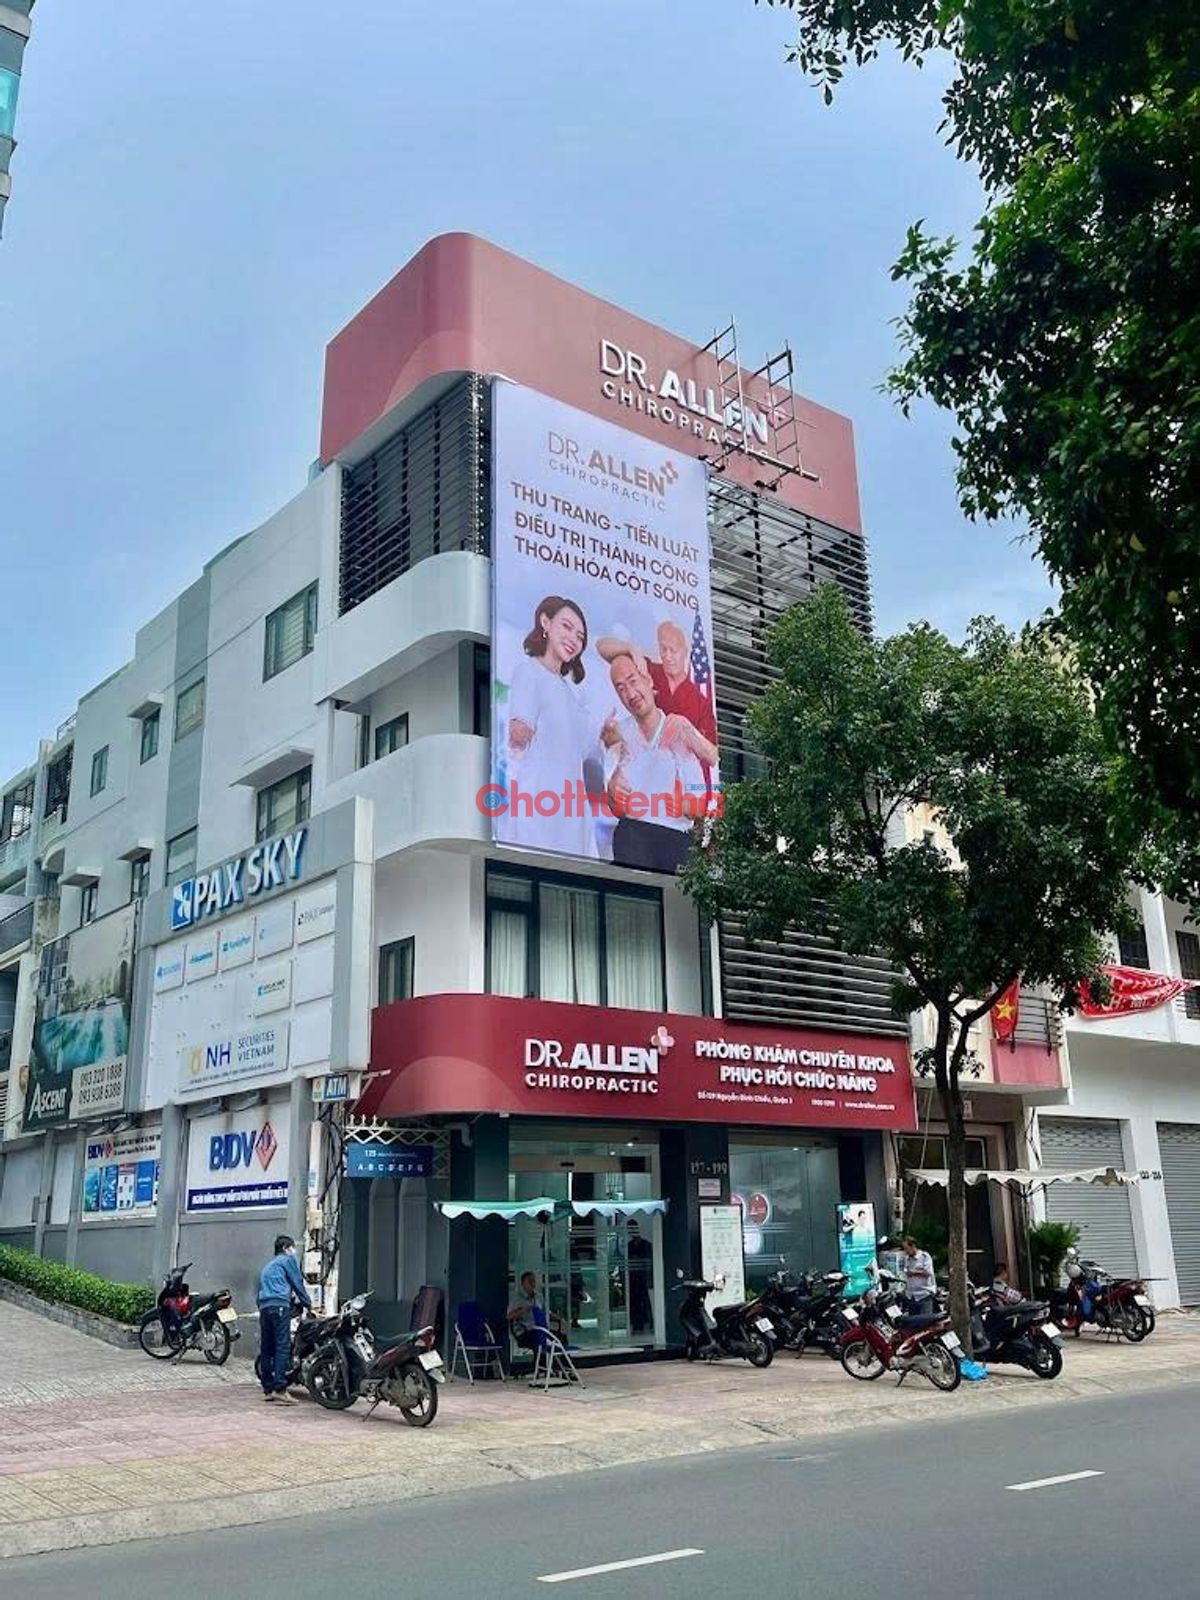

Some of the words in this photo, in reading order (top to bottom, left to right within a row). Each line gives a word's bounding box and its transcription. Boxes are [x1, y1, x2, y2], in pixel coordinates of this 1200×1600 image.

[549, 458, 667, 513] CHIROPRACTIC
[510, 482, 547, 507] THU
[551, 496, 611, 531] TRANG
[662, 536, 699, 563] LUẬT
[514, 535, 570, 568] THOÁI
[574, 556, 611, 582] HÓA
[615, 570, 650, 595] CỘT
[559, 527, 585, 554] TRỊ
[589, 537, 646, 571] THÀNH
[650, 559, 699, 588] CÔNG
[193, 856, 246, 921] PAX
[246, 827, 308, 897] SKY
[206, 1041, 232, 1070] NH
[237, 1044, 275, 1062] VIETNAM
[695, 1038, 752, 1061] PHÒNG
[753, 1043, 798, 1066] KHÁM
[798, 1050, 856, 1071] CHUYÊN
[857, 1055, 896, 1074] KHOA
[325, 1077, 347, 1098] ATM
[525, 1073, 660, 1093] CHIROPRACTIC
[719, 1065, 763, 1088] PHỤC
[208, 1130, 257, 1172] BIDV
